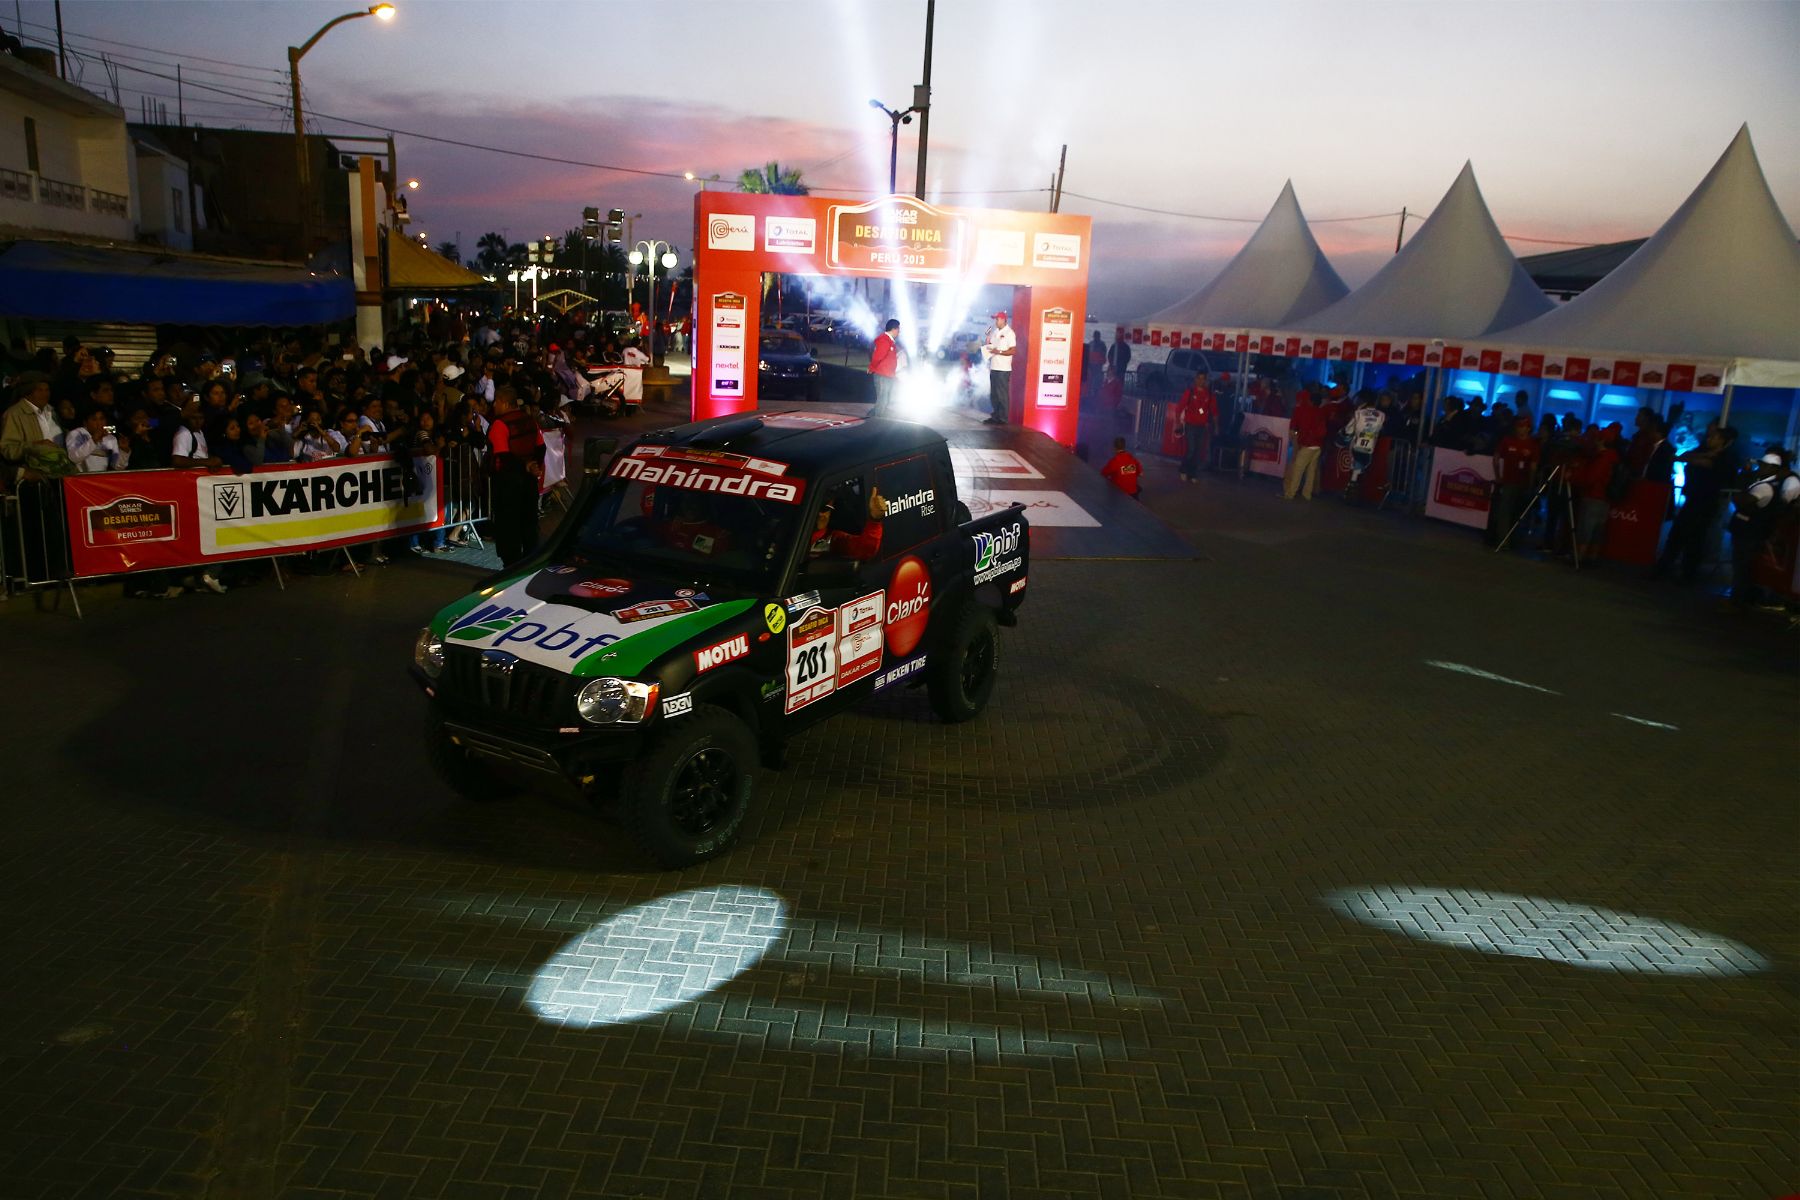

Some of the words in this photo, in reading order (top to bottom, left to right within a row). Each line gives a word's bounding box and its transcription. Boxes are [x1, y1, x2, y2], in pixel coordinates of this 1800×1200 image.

[912, 229, 941, 242] INCA
[903, 254, 925, 265] 2013
[611, 458, 797, 501] Mahindra
[250, 466, 424, 517] KÄRCHE
[103, 515, 138, 525] DESAFIO
[140, 513, 160, 522] INCA
[1609, 507, 1639, 522] erú
[118, 531, 137, 539] PERU
[992, 523, 1020, 565] pbf
[579, 581, 622, 593] Claro
[859, 606, 873, 614] TOTAL
[887, 596, 925, 625] Claro
[491, 622, 621, 659] pbf
[698, 636, 748, 671] MOTUL
[796, 642, 827, 685] 201
[841, 665, 860, 678] DAKAR
[886, 663, 910, 684] NEXEN
[911, 655, 927, 672] TIRE
